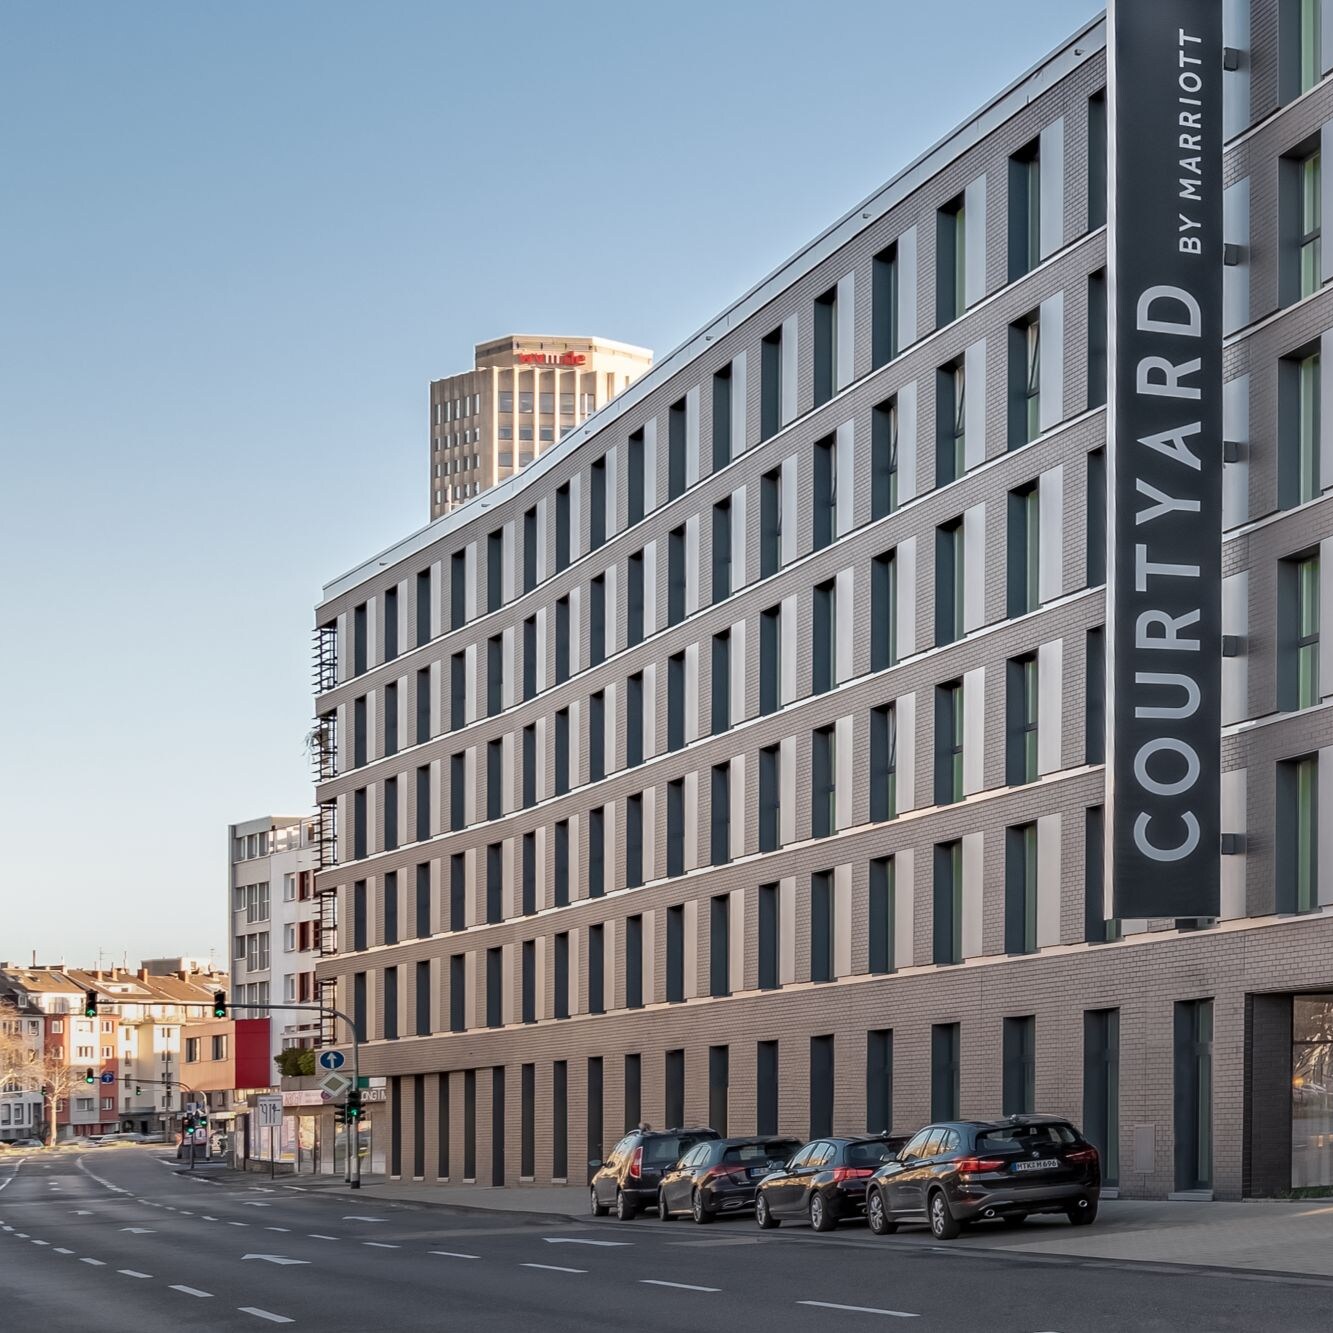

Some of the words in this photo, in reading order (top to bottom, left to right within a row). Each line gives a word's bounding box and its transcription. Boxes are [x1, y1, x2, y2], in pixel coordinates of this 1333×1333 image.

[1178, 28, 1202, 201] MARRIOTT
[1178, 213, 1202, 255] BY
[1133, 285, 1202, 862] COURTYARD
